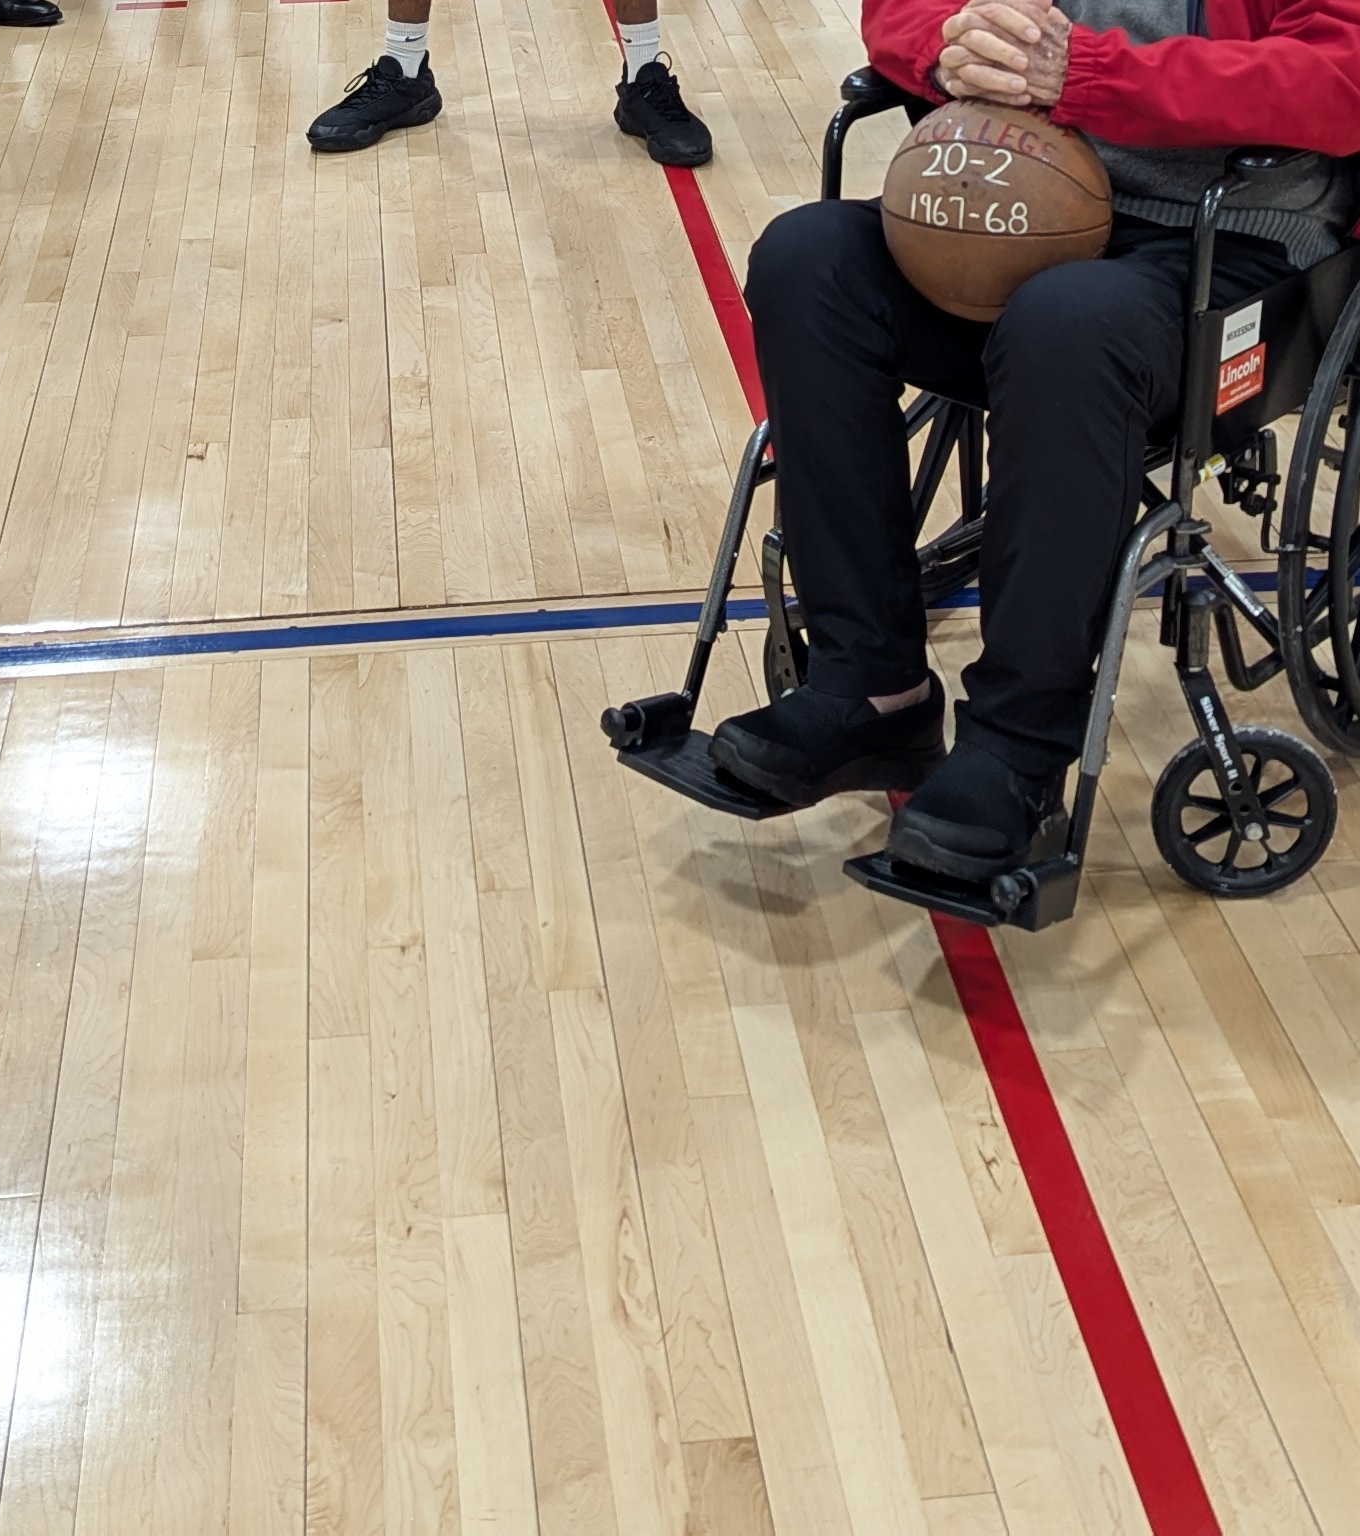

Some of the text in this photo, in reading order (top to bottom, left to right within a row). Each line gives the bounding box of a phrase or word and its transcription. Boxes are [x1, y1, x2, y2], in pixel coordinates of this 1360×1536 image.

[913, 117, 1058, 162] COLLEGE
[921, 143, 1013, 187] 20-2
[910, 193, 1029, 235] 1967-68
[1219, 353, 1261, 390] Lincoln
[1200, 695, 1220, 732] Silver
[1214, 733, 1233, 769] Sport
